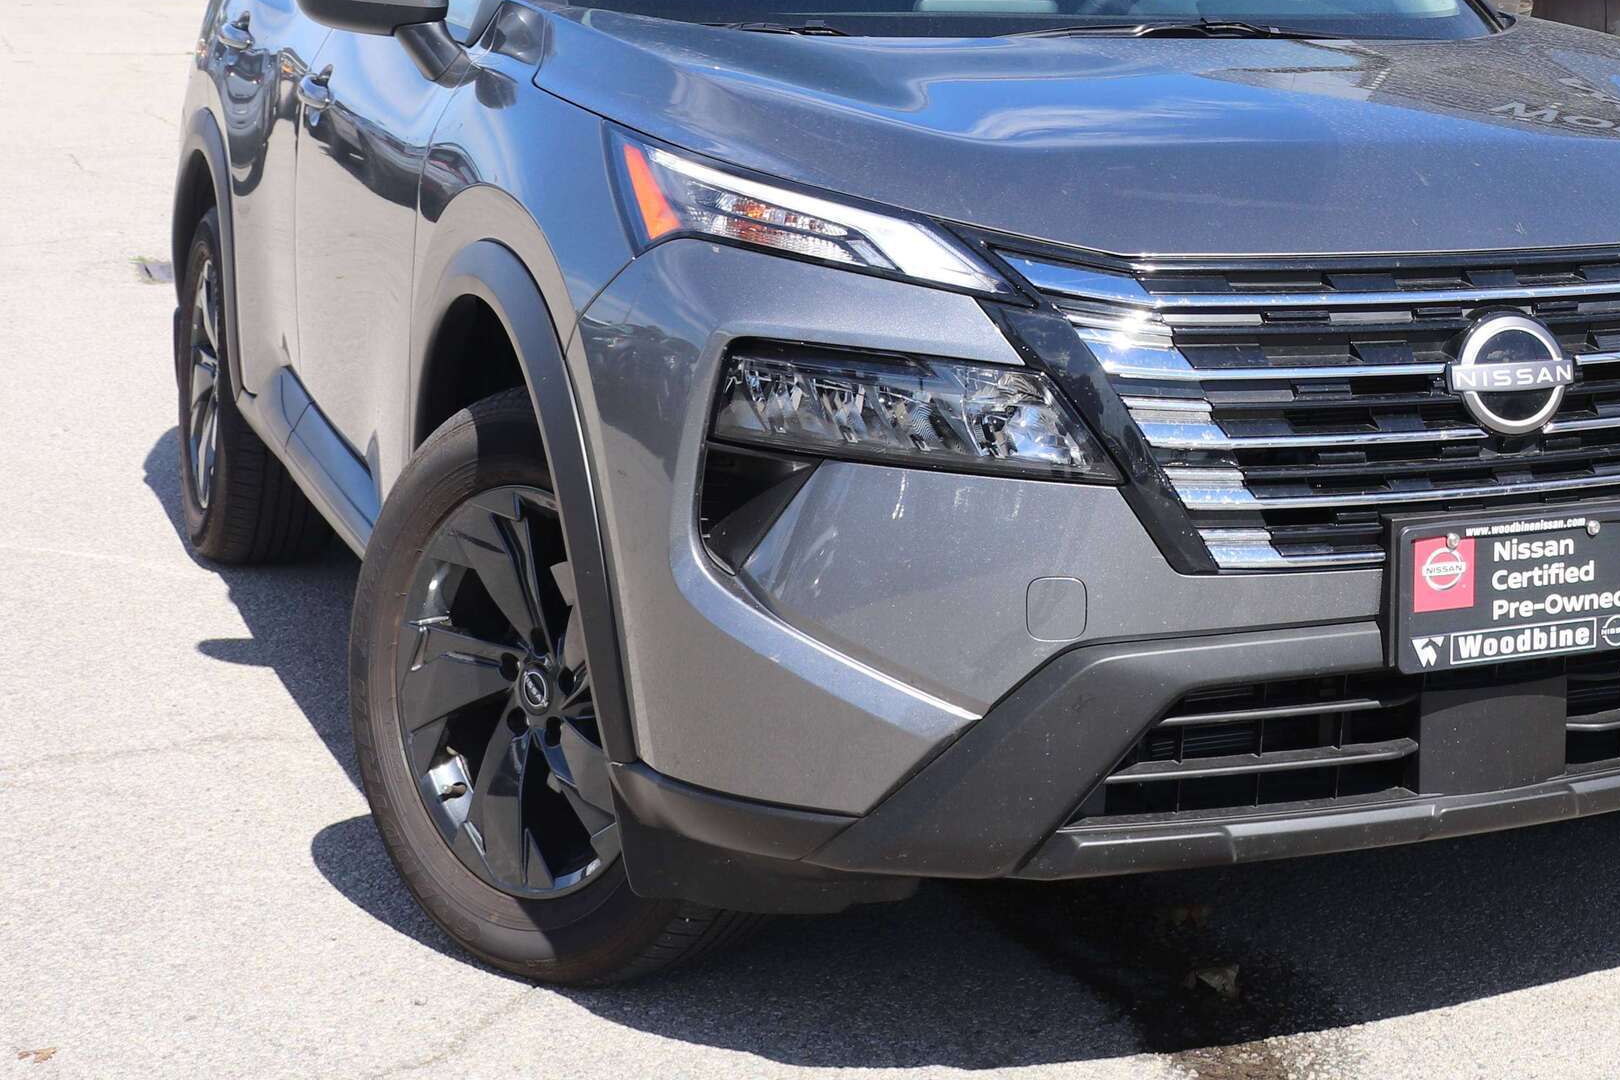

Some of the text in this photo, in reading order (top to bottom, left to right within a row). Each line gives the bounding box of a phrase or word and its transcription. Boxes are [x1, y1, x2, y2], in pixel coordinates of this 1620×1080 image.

[1455, 363, 1573, 389] NISSAN
[1465, 518, 1586, 537] www.woodbinenissan.com
[1493, 538, 1575, 562] Nissan
[1426, 564, 1463, 575] NISSAN
[1491, 560, 1595, 591] Certified
[1458, 625, 1591, 659] Woodbine
